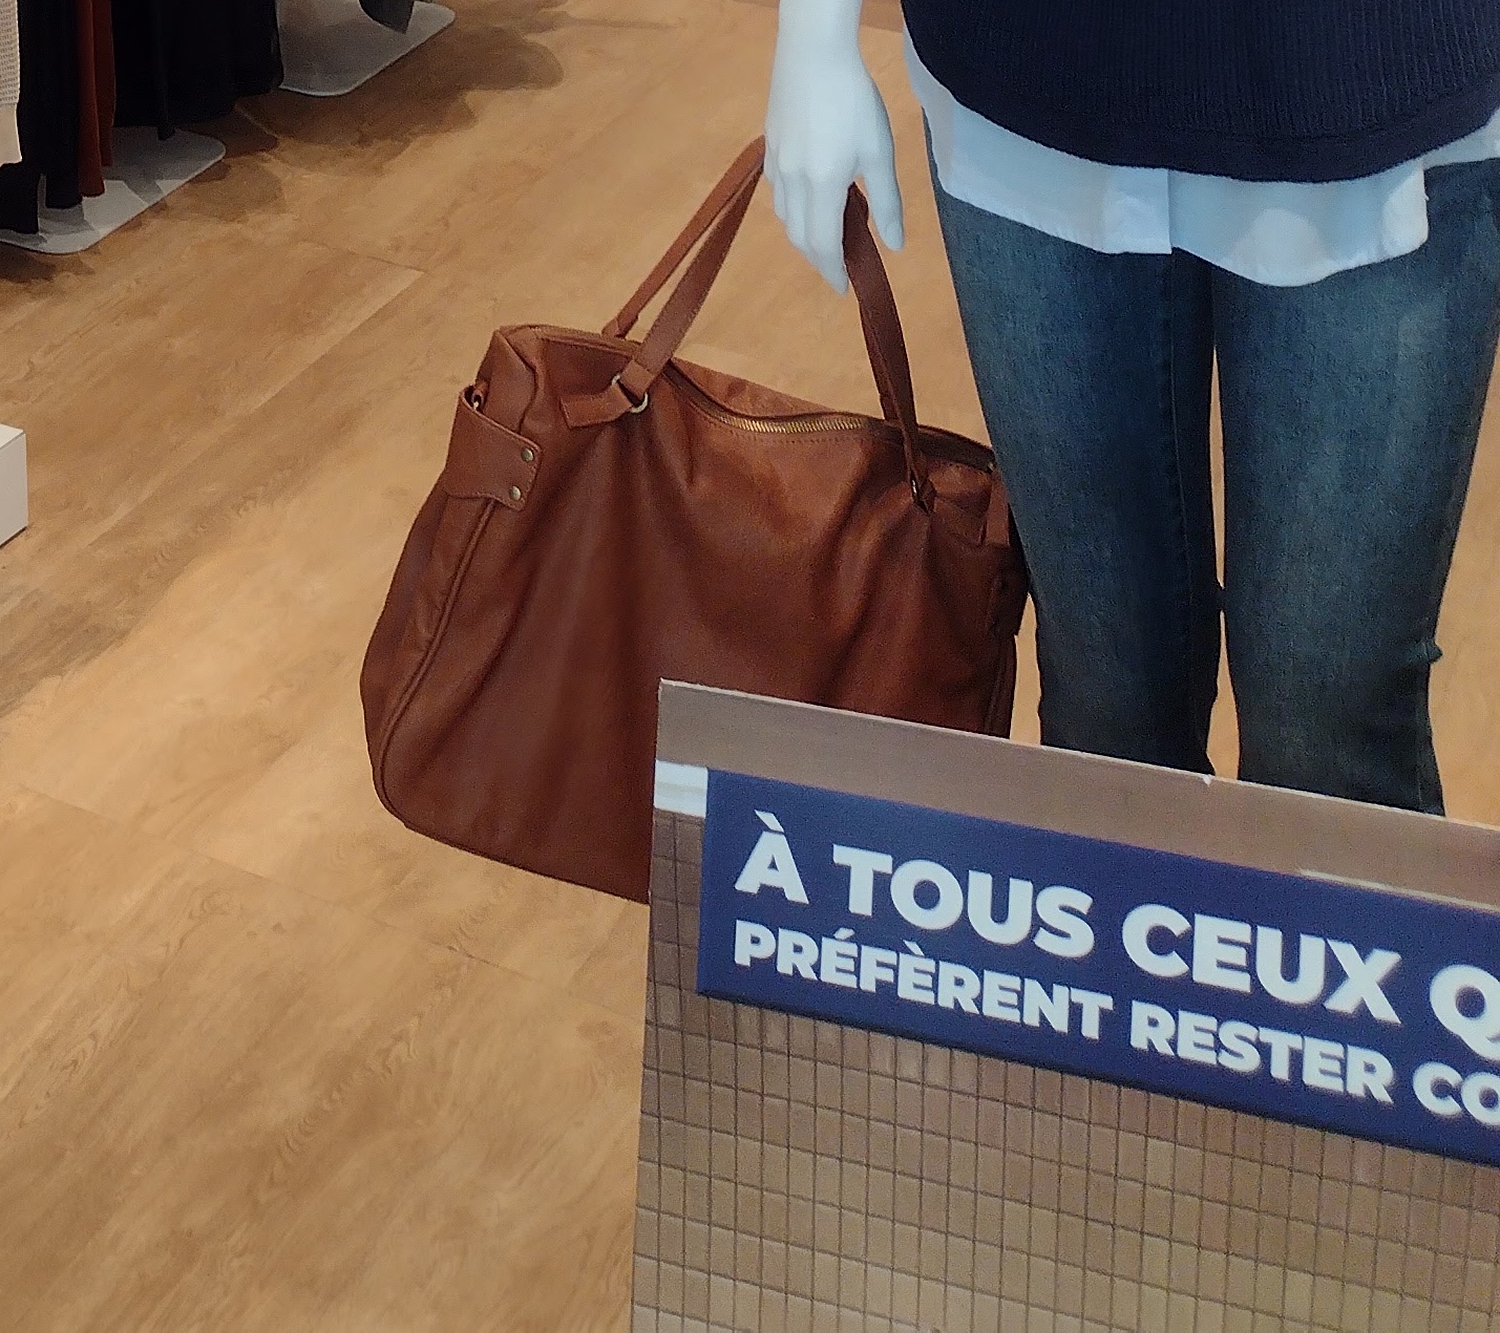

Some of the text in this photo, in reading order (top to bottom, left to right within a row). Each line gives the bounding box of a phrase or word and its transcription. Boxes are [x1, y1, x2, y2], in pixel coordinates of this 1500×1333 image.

[734, 809, 810, 905] À
[832, 843, 1095, 959] TOUS
[1121, 903, 1403, 1025] CEUX
[734, 919, 1114, 1041] PRÉFÈRENT
[1130, 999, 1396, 1105] RESTER
